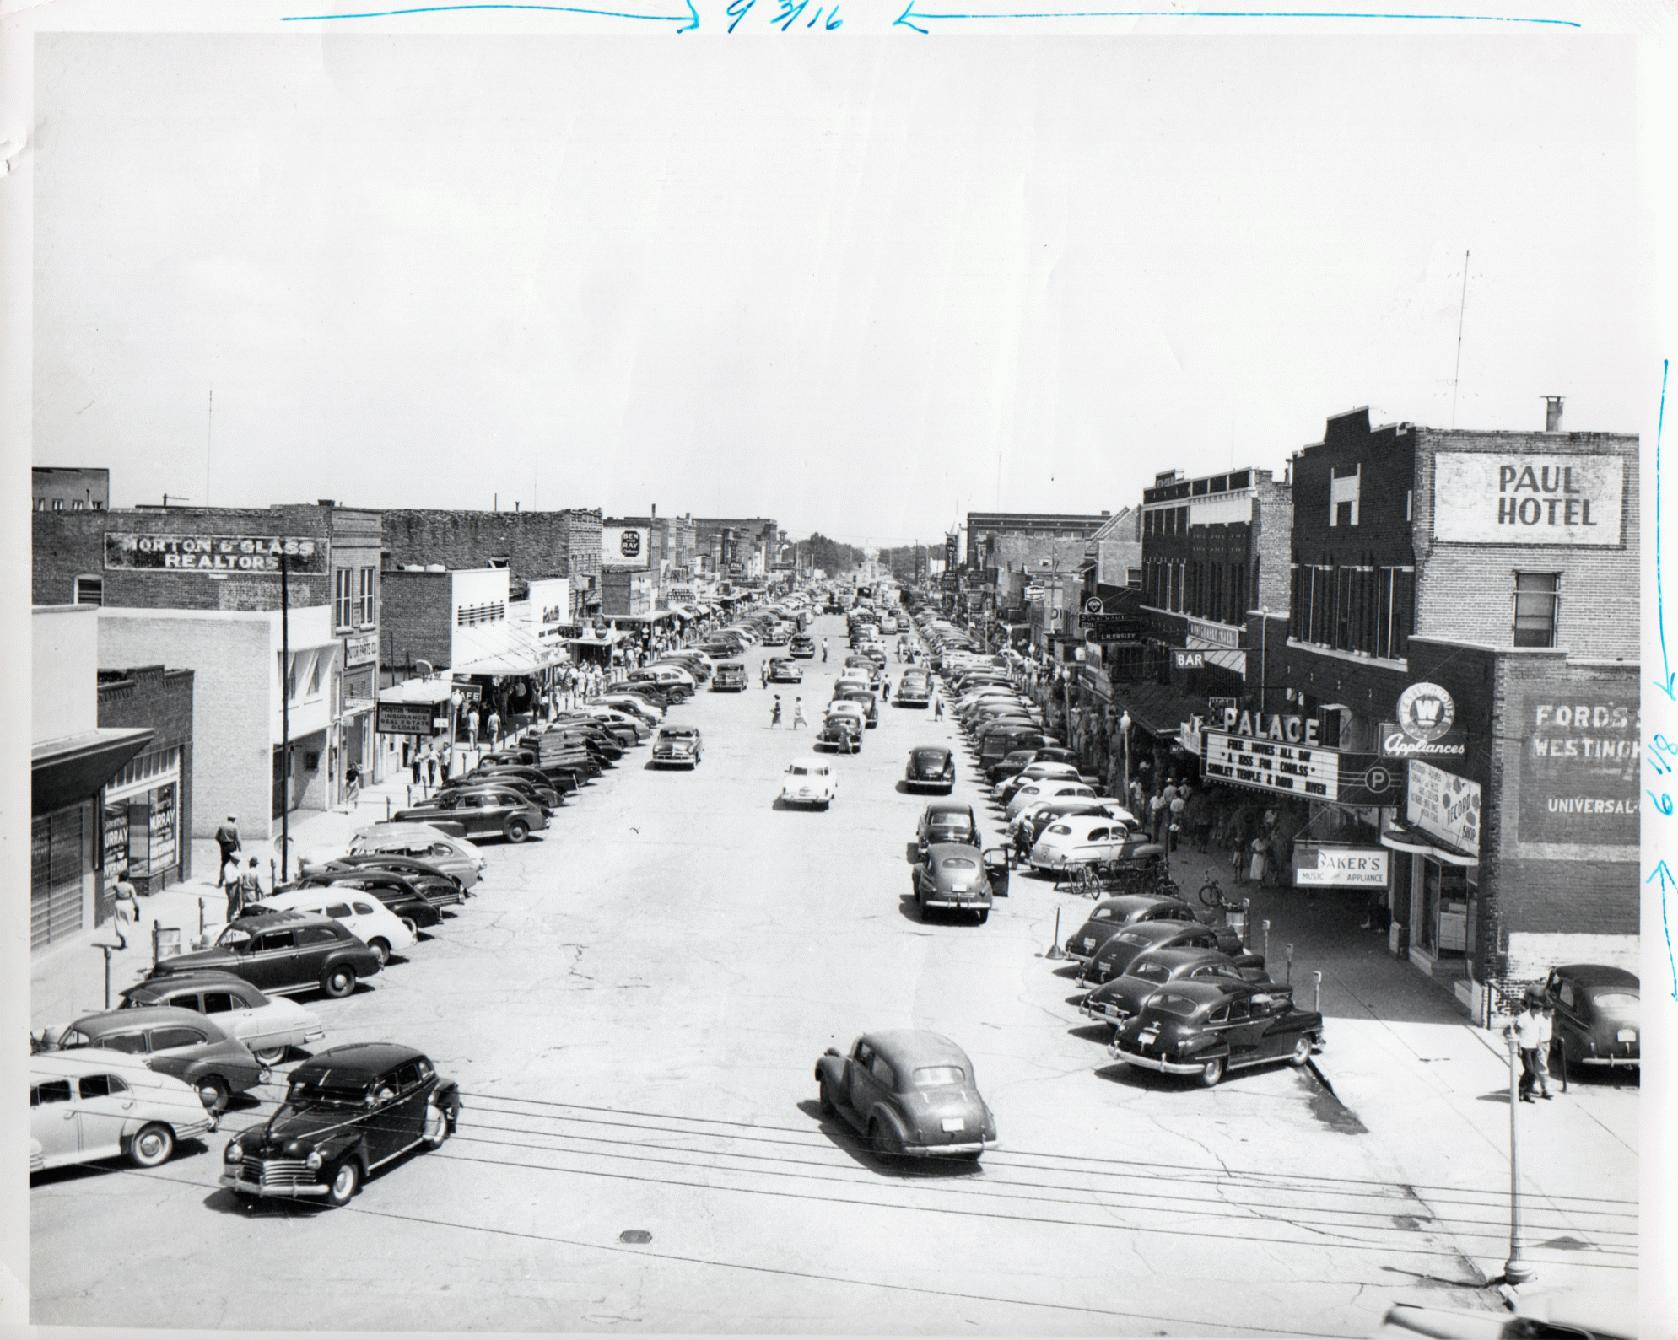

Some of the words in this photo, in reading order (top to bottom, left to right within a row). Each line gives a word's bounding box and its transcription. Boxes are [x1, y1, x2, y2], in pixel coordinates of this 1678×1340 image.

[1499, 465, 1580, 494] PAUL
[1497, 497, 1598, 526] HOTEL
[241, 539, 315, 556] GLASS
[164, 553, 279, 570] REALTORS
[1177, 653, 1203, 666] BAR
[1223, 707, 1320, 746] PALACE
[1384, 733, 1466, 756] Appliances
[1372, 771, 1385, 788] P
[1346, 873, 1384, 882] APPLIANCE
